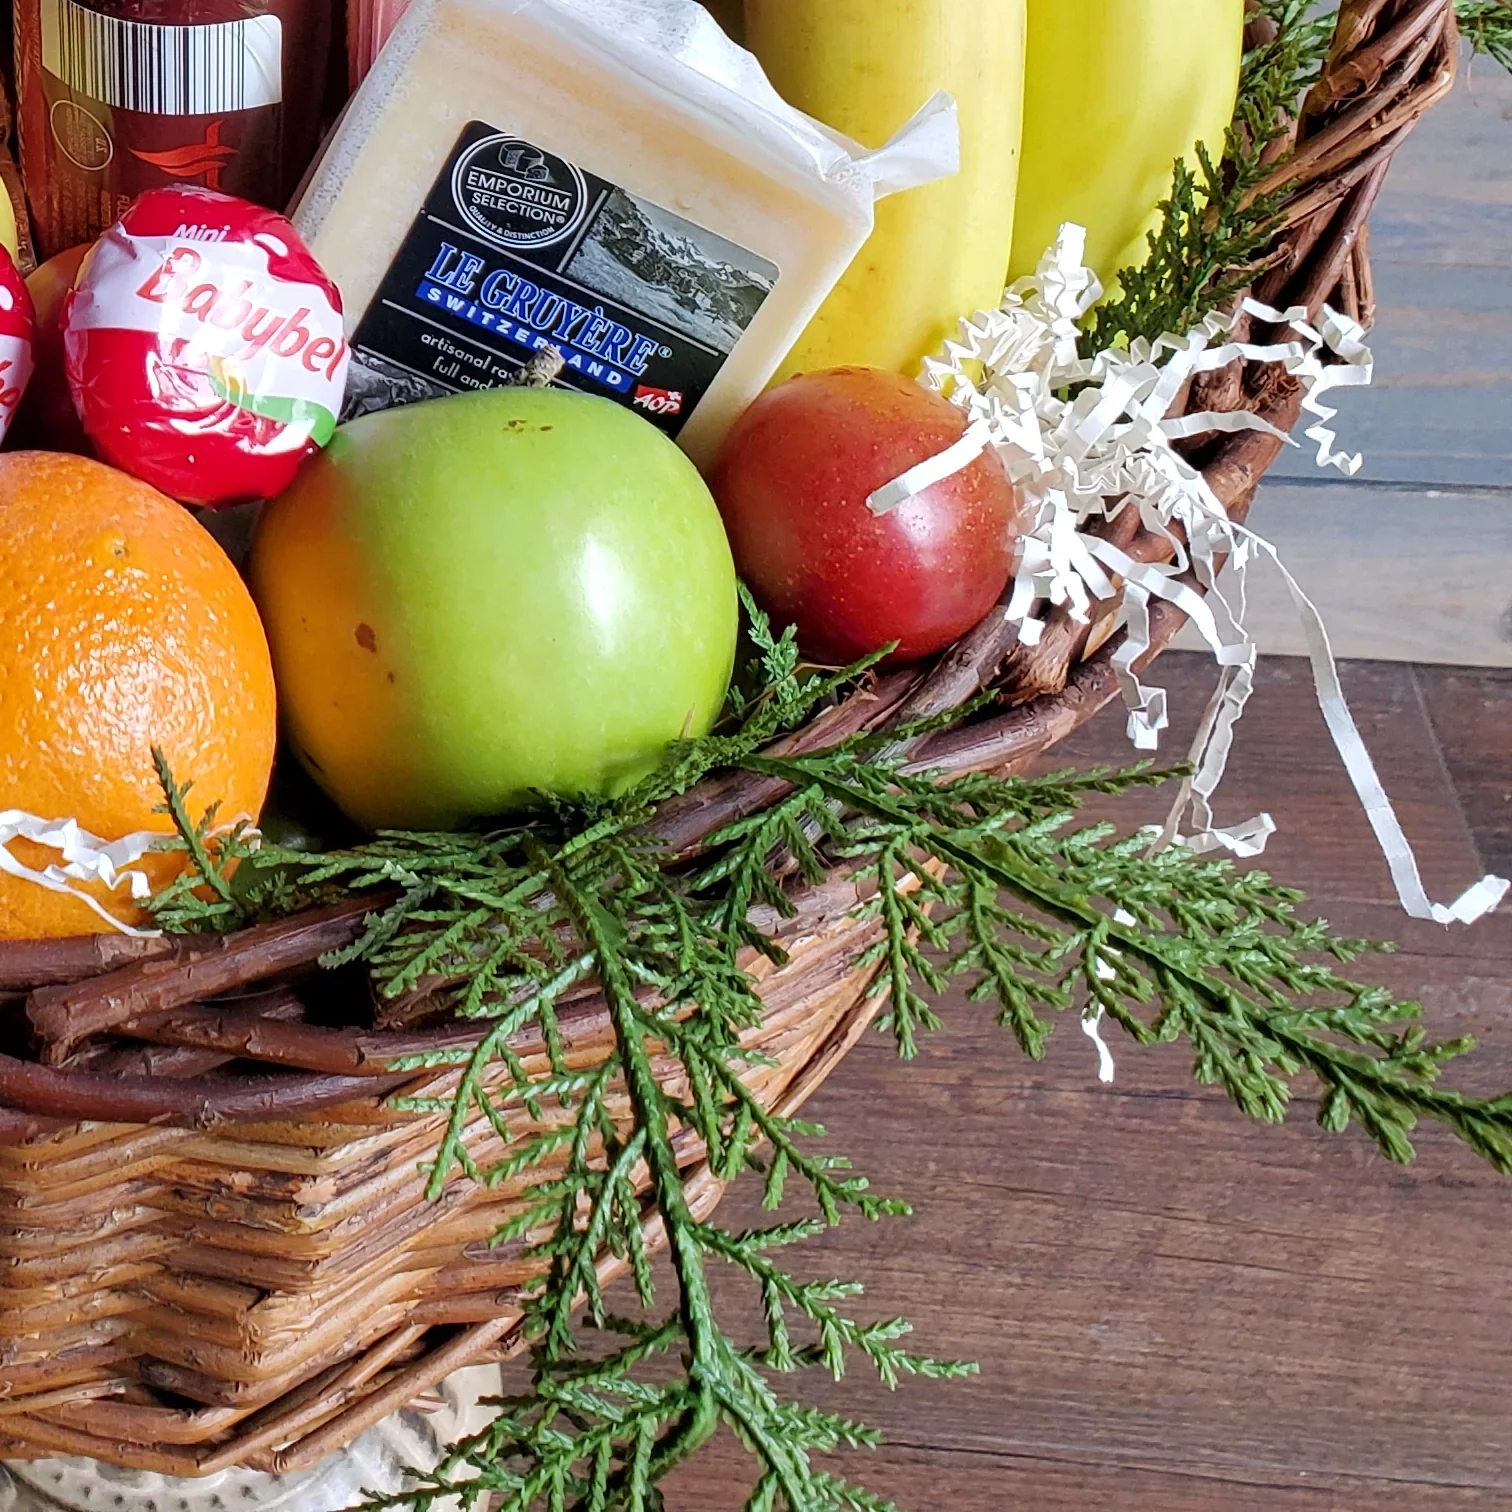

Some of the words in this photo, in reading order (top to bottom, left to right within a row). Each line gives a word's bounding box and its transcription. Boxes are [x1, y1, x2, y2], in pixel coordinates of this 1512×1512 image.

[466, 170, 571, 211] EMPORIUM
[173, 224, 231, 243] Mini
[503, 225, 556, 240] DISTINCTION
[425, 241, 486, 294] LE
[135, 246, 346, 383] Babybel
[420, 332, 493, 373] artisanal
[432, 356, 461, 380] full
[633, 392, 681, 415] AOP
